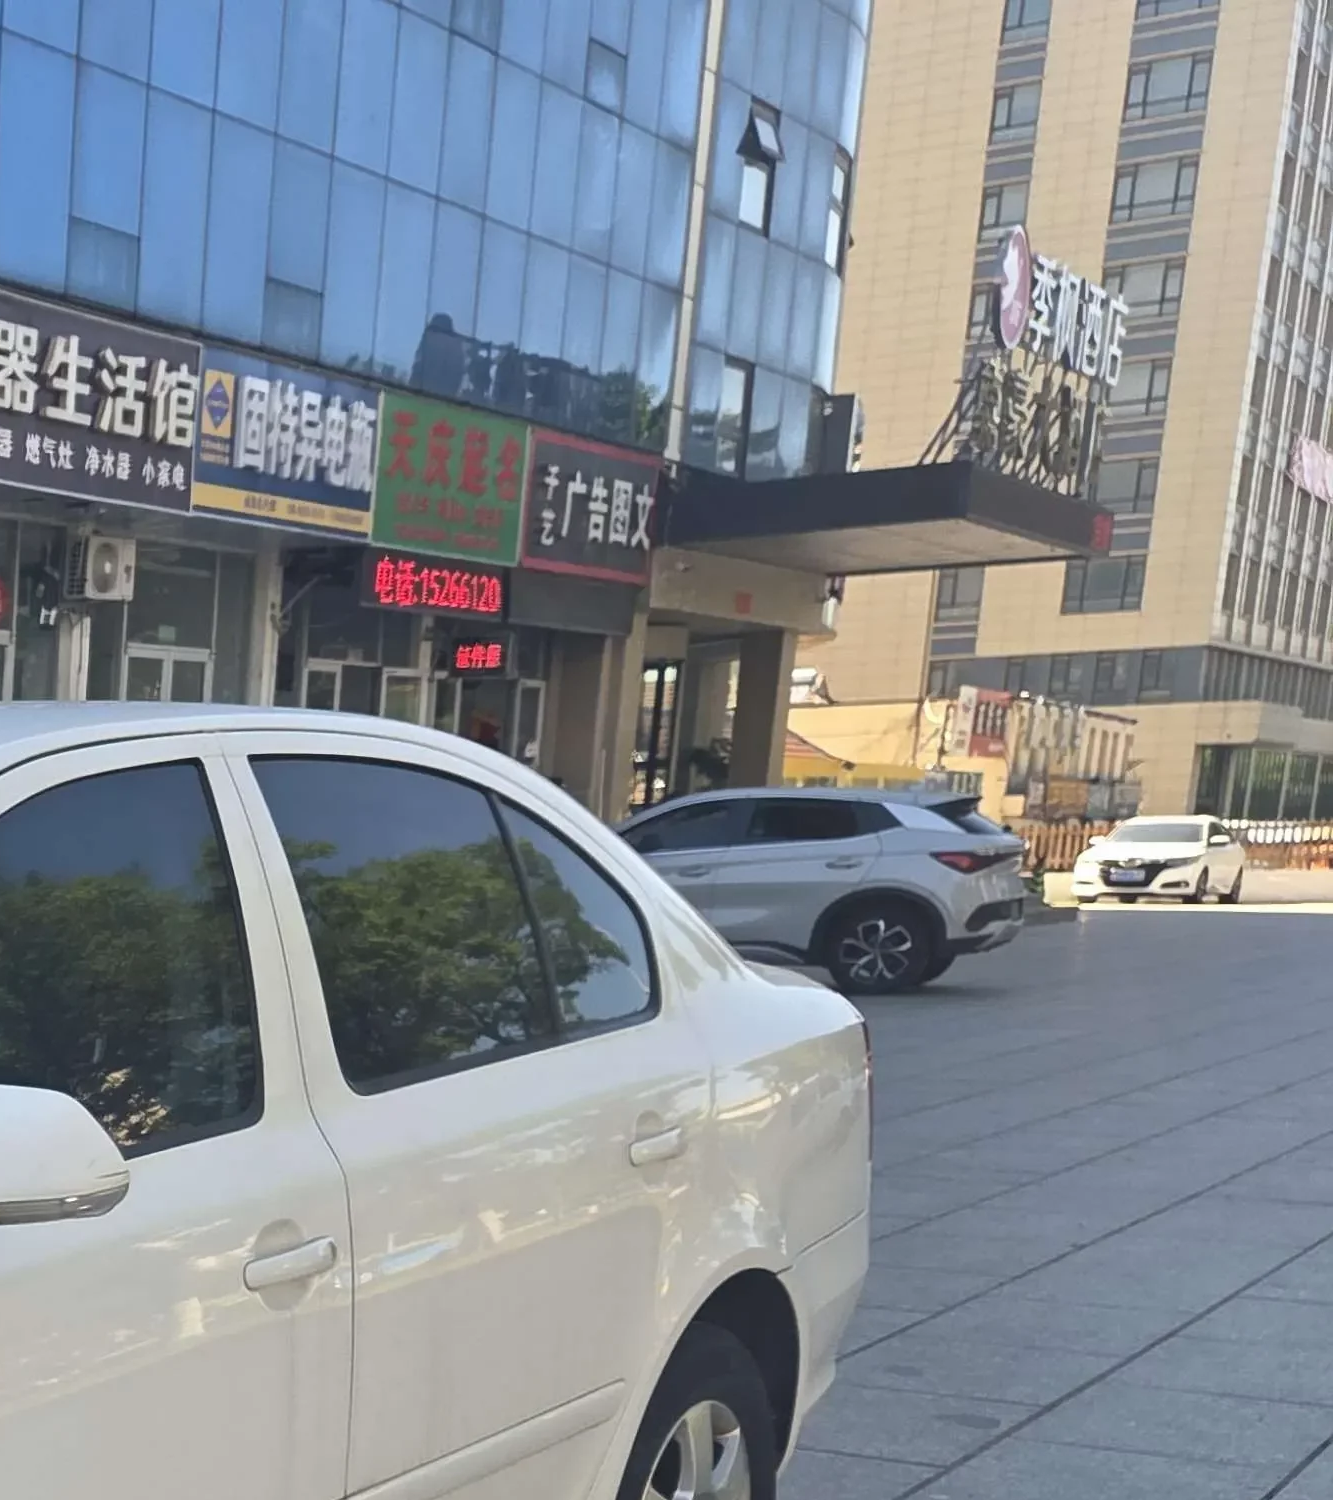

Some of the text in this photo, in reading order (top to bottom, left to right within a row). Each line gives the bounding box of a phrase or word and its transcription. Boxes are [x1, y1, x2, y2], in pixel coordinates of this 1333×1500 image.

[25, 432, 75, 470] 燃气灶
[85, 445, 132, 481] 净水器
[141, 456, 188, 491] 小家电
[238, 375, 378, 493] 固特异电瓶
[561, 469, 656, 552] 广告图文
